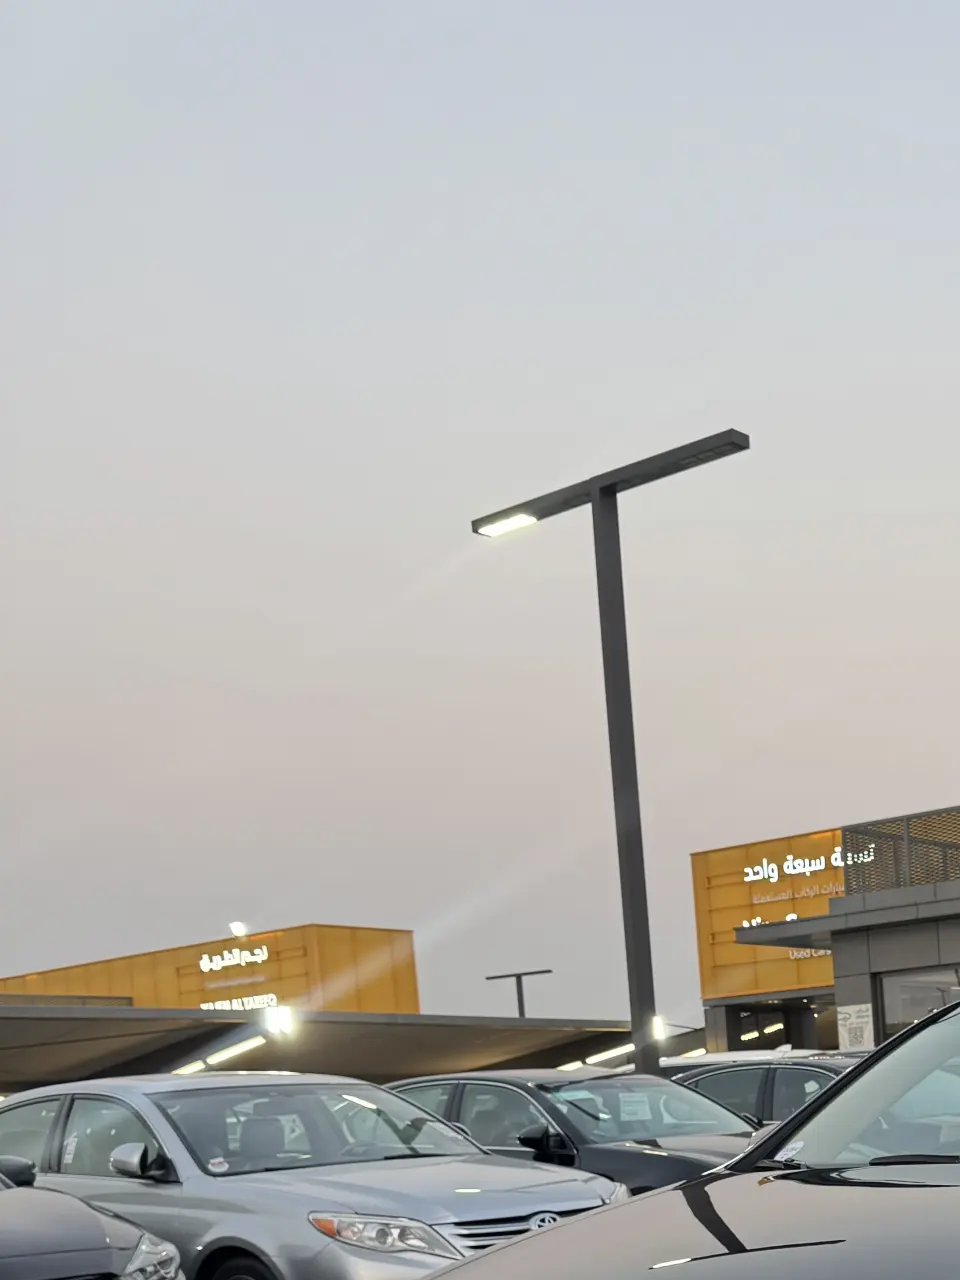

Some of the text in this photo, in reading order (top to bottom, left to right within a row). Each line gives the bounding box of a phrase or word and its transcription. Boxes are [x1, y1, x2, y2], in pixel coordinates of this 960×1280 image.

[744, 858, 778, 882] واحد
[783, 854, 825, 876] سبعة
[788, 949, 811, 960] Used
